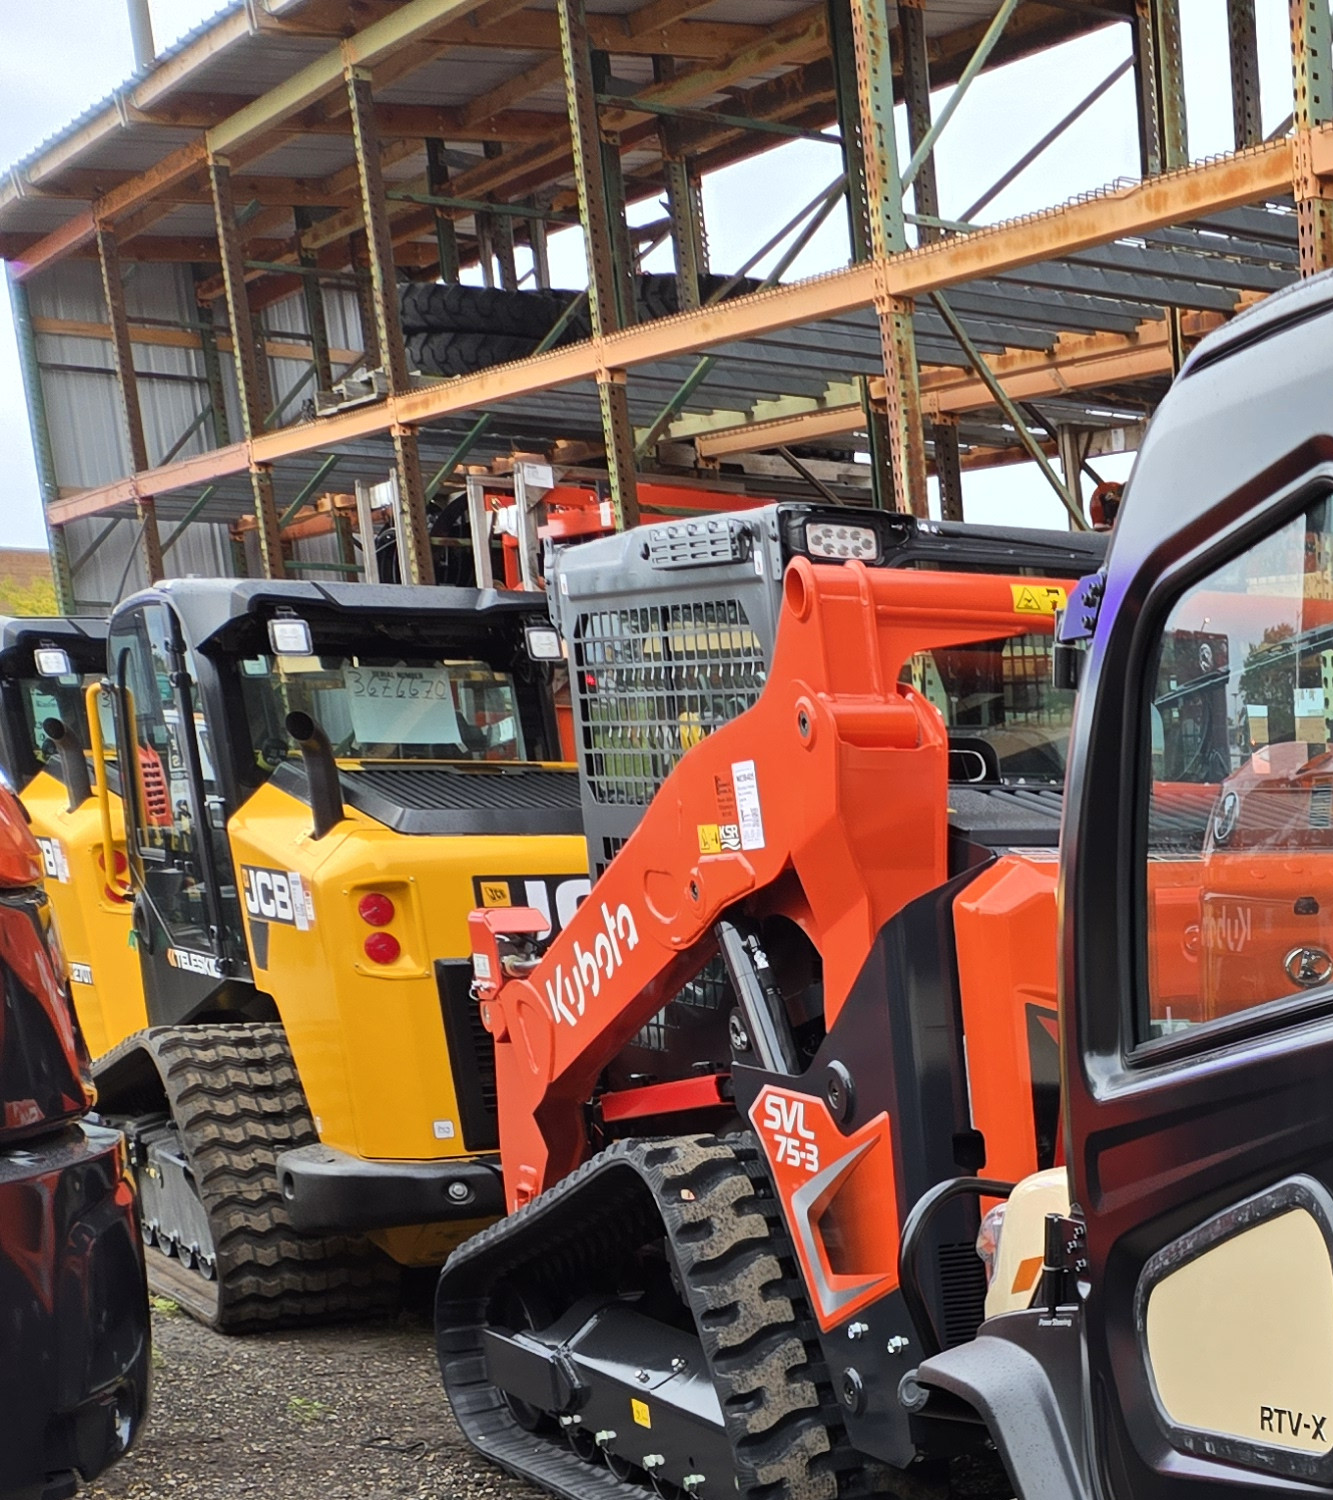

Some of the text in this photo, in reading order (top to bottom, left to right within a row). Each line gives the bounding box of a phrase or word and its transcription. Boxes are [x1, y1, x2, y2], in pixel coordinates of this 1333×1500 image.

[245, 869, 294, 921] JCB
[523, 877, 592, 941] JC
[545, 901, 639, 1027] Kubota
[763, 1093, 815, 1141] SVL
[773, 1133, 819, 1173] 75-3
[1259, 1405, 1327, 1442] RTV-X
